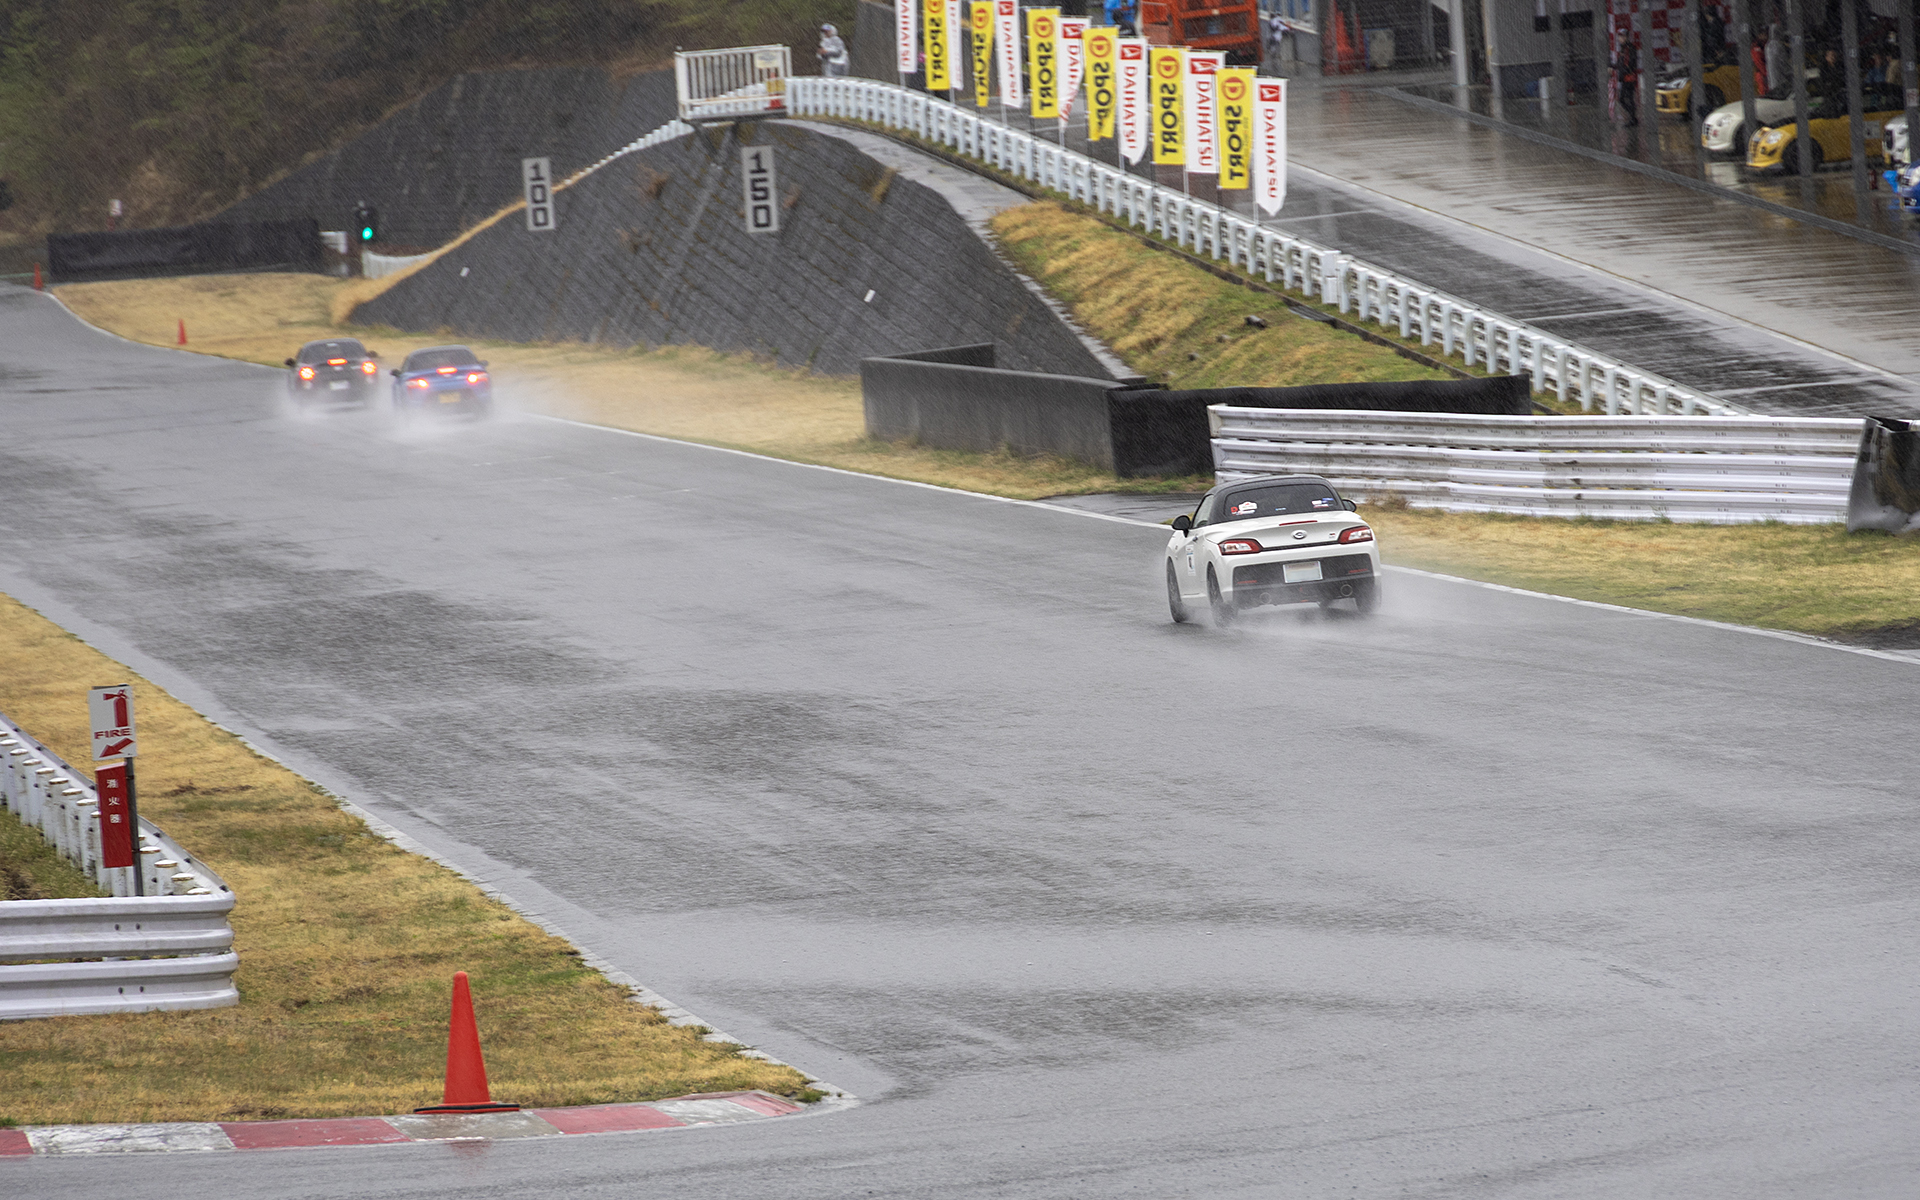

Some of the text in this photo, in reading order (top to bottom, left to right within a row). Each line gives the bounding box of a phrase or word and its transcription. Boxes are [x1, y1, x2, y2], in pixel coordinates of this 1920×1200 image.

[1123, 66, 1138, 149] DAIHATSU
[1196, 81, 1213, 167] DAIHATSU
[750, 152, 772, 229] 150
[1263, 108, 1279, 199] DAIHATSU
[529, 161, 549, 227] 100
[94, 728, 132, 739] FIRE
[106, 779, 121, 824] 消火器
